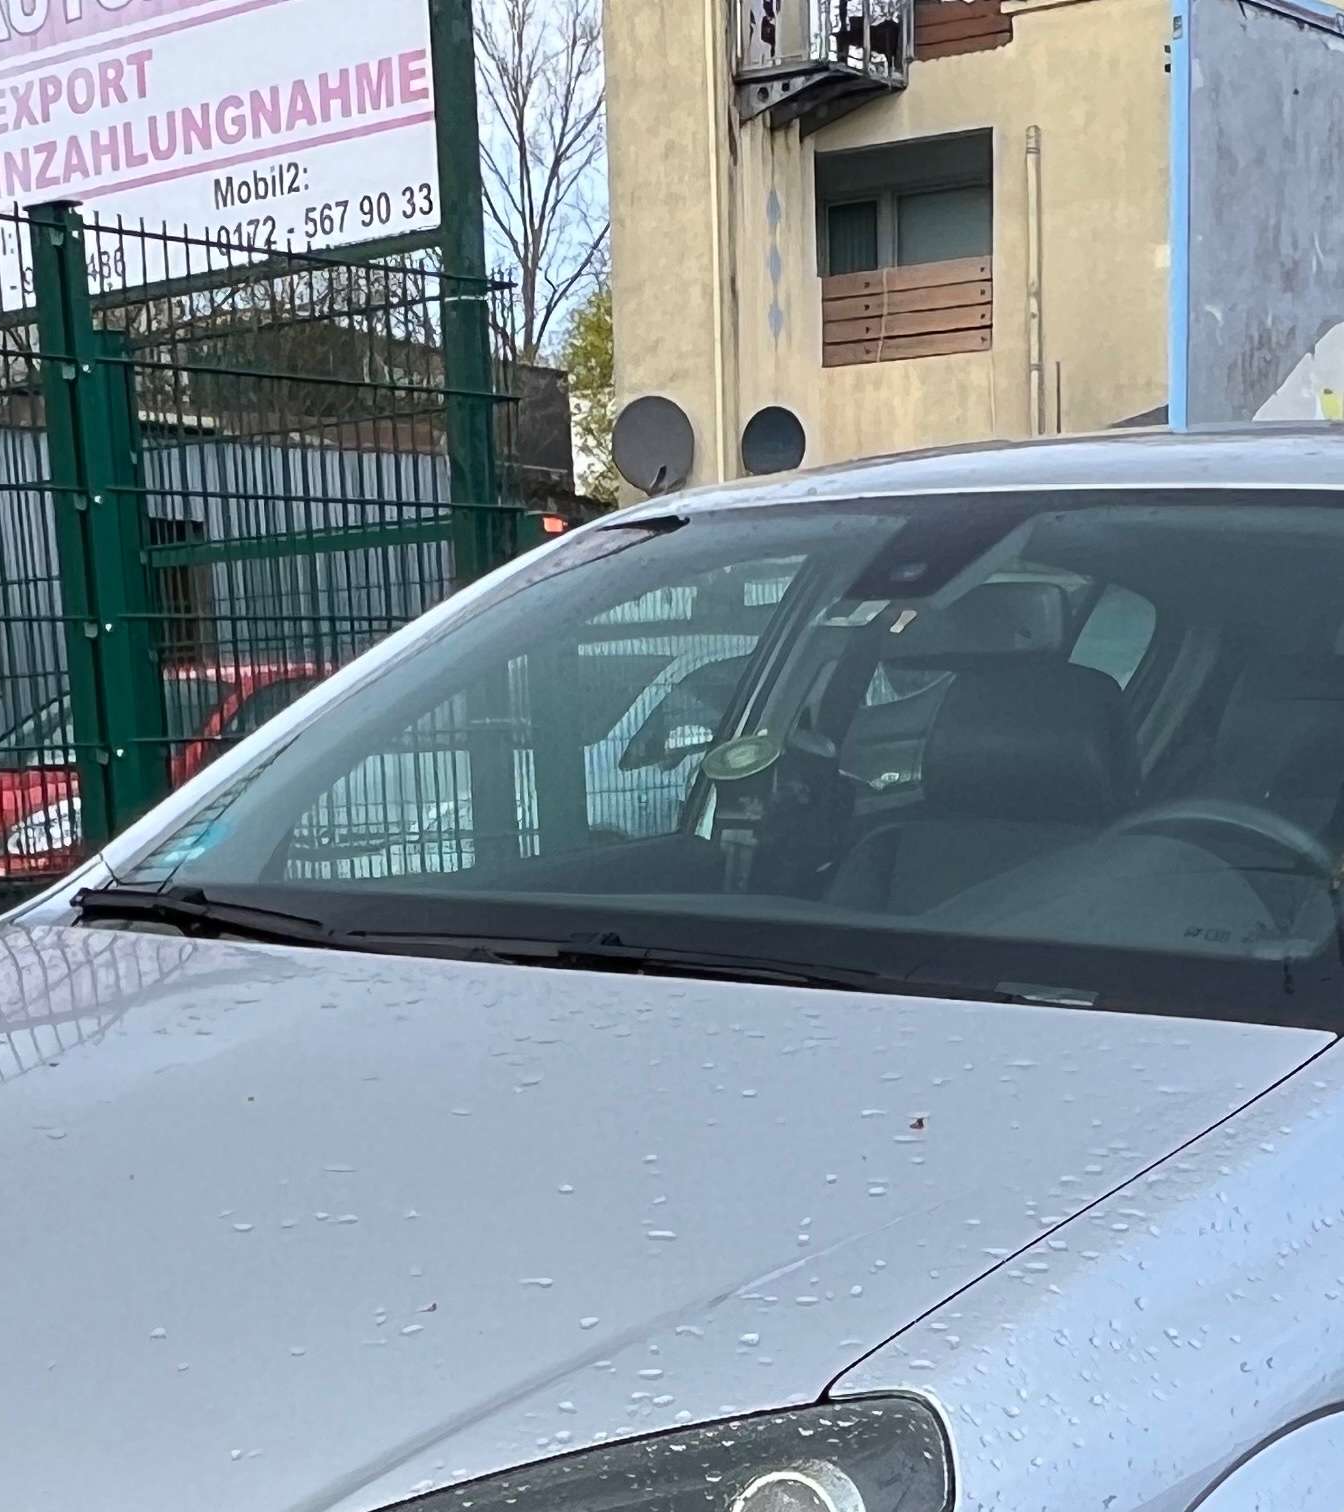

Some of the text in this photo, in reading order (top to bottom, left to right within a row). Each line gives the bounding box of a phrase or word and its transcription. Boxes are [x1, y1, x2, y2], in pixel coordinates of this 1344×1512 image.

[213, 162, 310, 210] Mobil2:
[217, 215, 278, 257] 0172
[304, 200, 350, 239] 567
[359, 191, 392, 228] 90
[401, 182, 435, 219] 33
